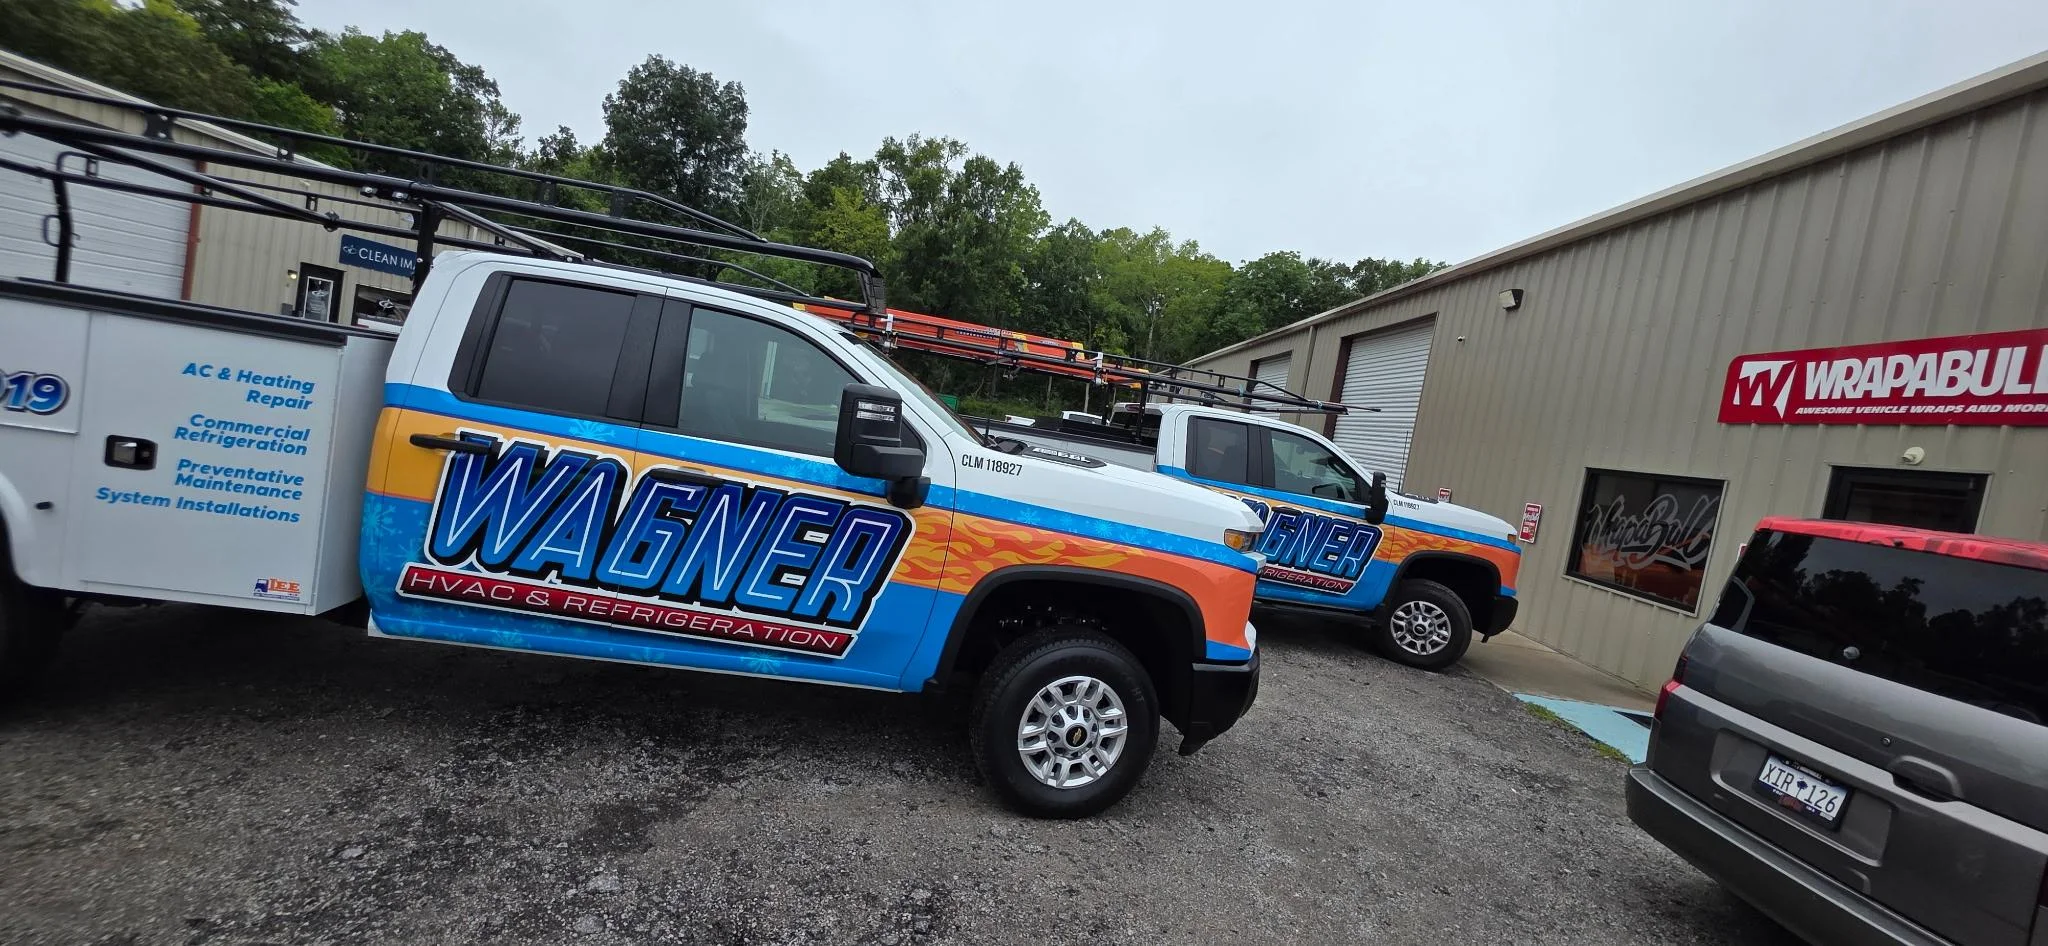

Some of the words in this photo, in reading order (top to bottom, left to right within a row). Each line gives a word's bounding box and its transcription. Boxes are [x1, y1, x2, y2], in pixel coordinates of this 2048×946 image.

[358, 248, 398, 266] CLEAN
[401, 257, 416, 270] IM
[0, 371, 69, 414] 19
[182, 363, 214, 377] AC
[217, 367, 232, 380] &
[236, 370, 316, 394] Heating
[246, 389, 313, 410] Repair
[1795, 406, 1855, 415] AWESOME
[1856, 405, 1907, 414] VEHICLE
[1908, 404, 1964, 413] WRAPS
[1965, 403, 2001, 413] AND
[174, 426, 308, 456] Refrigeration
[189, 414, 311, 441] Commercial
[176, 458, 304, 486] Preventative
[961, 454, 984, 469] CLM
[986, 458, 1022, 476] 118927
[174, 473, 303, 500] Maintenance
[95, 487, 171, 507] System
[175, 497, 300, 523] Installations
[429, 433, 908, 626] WAGNER
[1243, 501, 1381, 576] GNER
[1264, 568, 1348, 590] RIGERATION
[409, 571, 515, 601] HVAC
[525, 586, 550, 606] &
[563, 594, 839, 649] REFRIGERATION
[1763, 763, 1795, 792] XIR
[1804, 785, 1838, 813] 126
